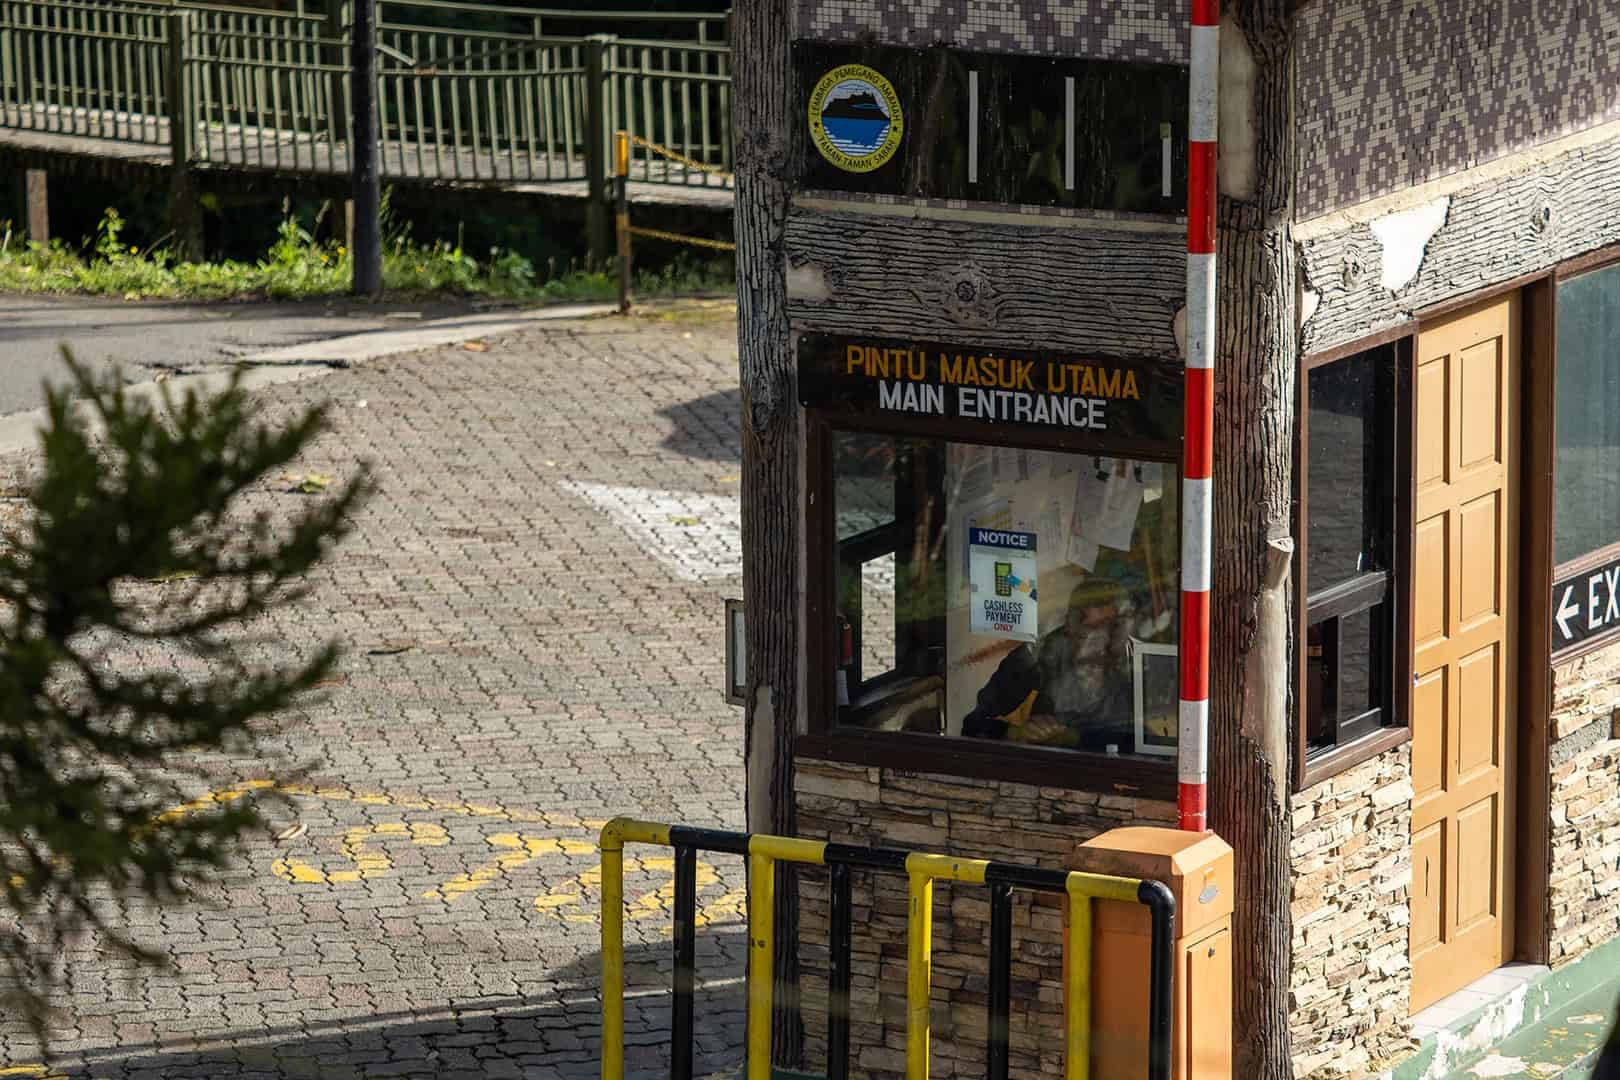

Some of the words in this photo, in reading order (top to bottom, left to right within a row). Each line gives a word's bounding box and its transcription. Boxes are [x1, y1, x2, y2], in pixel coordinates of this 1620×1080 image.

[812, 78, 833, 115] LEMBAGA
[835, 68, 880, 83] PEMEGANG
[881, 83, 900, 121] AMANAH
[818, 136, 872, 168] TAMAN-TAMAN
[874, 139, 895, 164] SABAH
[847, 344, 926, 381] PINTU
[939, 353, 1035, 391] MASUK
[1047, 362, 1140, 400] UTAMA
[879, 379, 944, 414] MAIN
[958, 387, 1107, 429] ENTRANCE
[979, 531, 1027, 546] NOTICE
[984, 600, 1023, 613] CASHLESS
[985, 612, 1022, 624] PAYMENT
[993, 622, 1014, 632] ONLY
